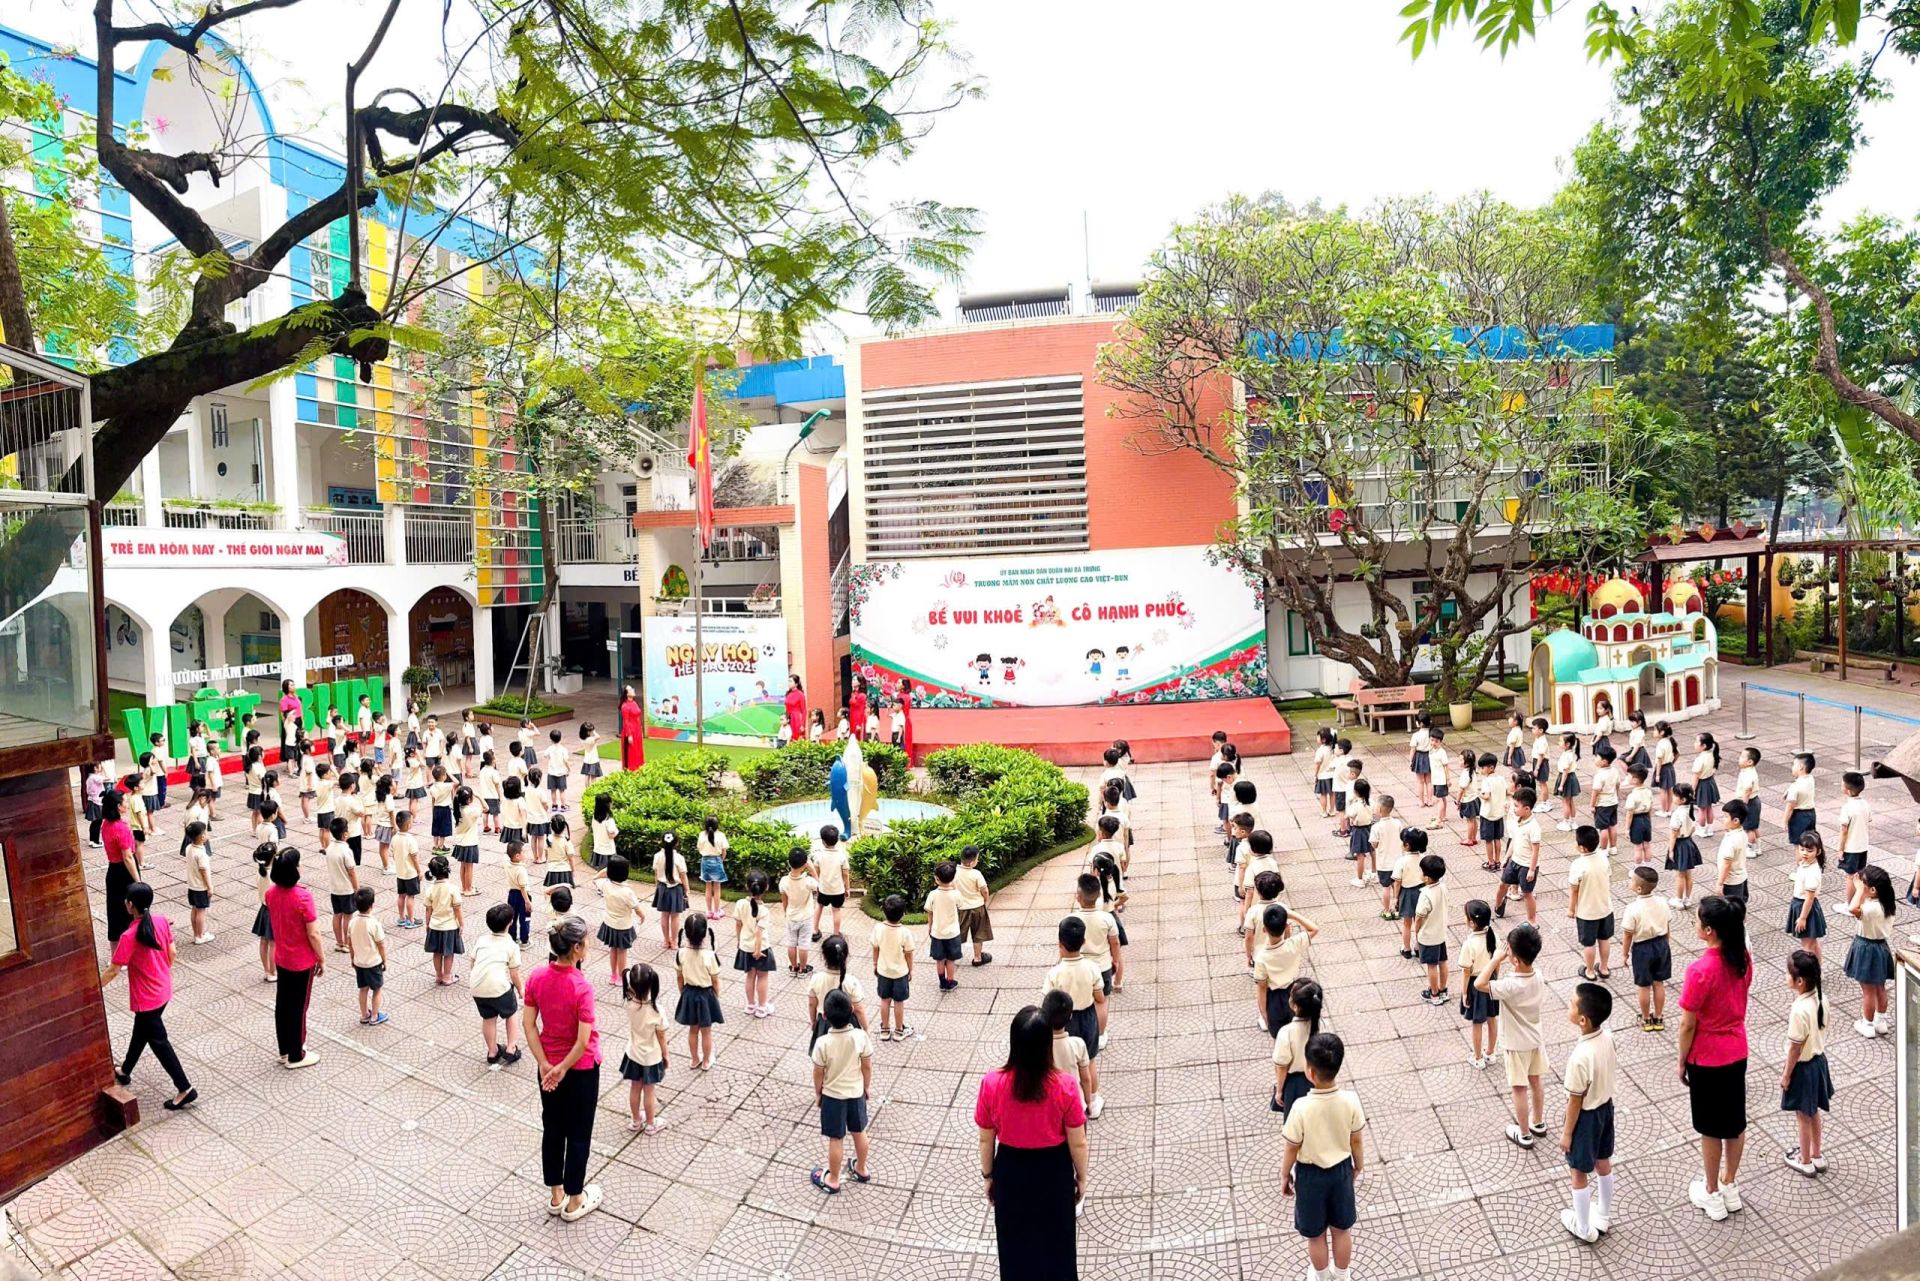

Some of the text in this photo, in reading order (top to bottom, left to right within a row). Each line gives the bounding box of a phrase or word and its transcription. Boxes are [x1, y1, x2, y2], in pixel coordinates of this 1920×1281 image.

[138, 543, 155, 554] EM
[192, 544, 214, 555] NAY
[305, 545, 324, 555] MAI
[928, 598, 1186, 625] BÉ VUI KHOẺ CÔ HẠNH PHÚC
[243, 664, 267, 677] NON
[335, 654, 354, 667] CAO
